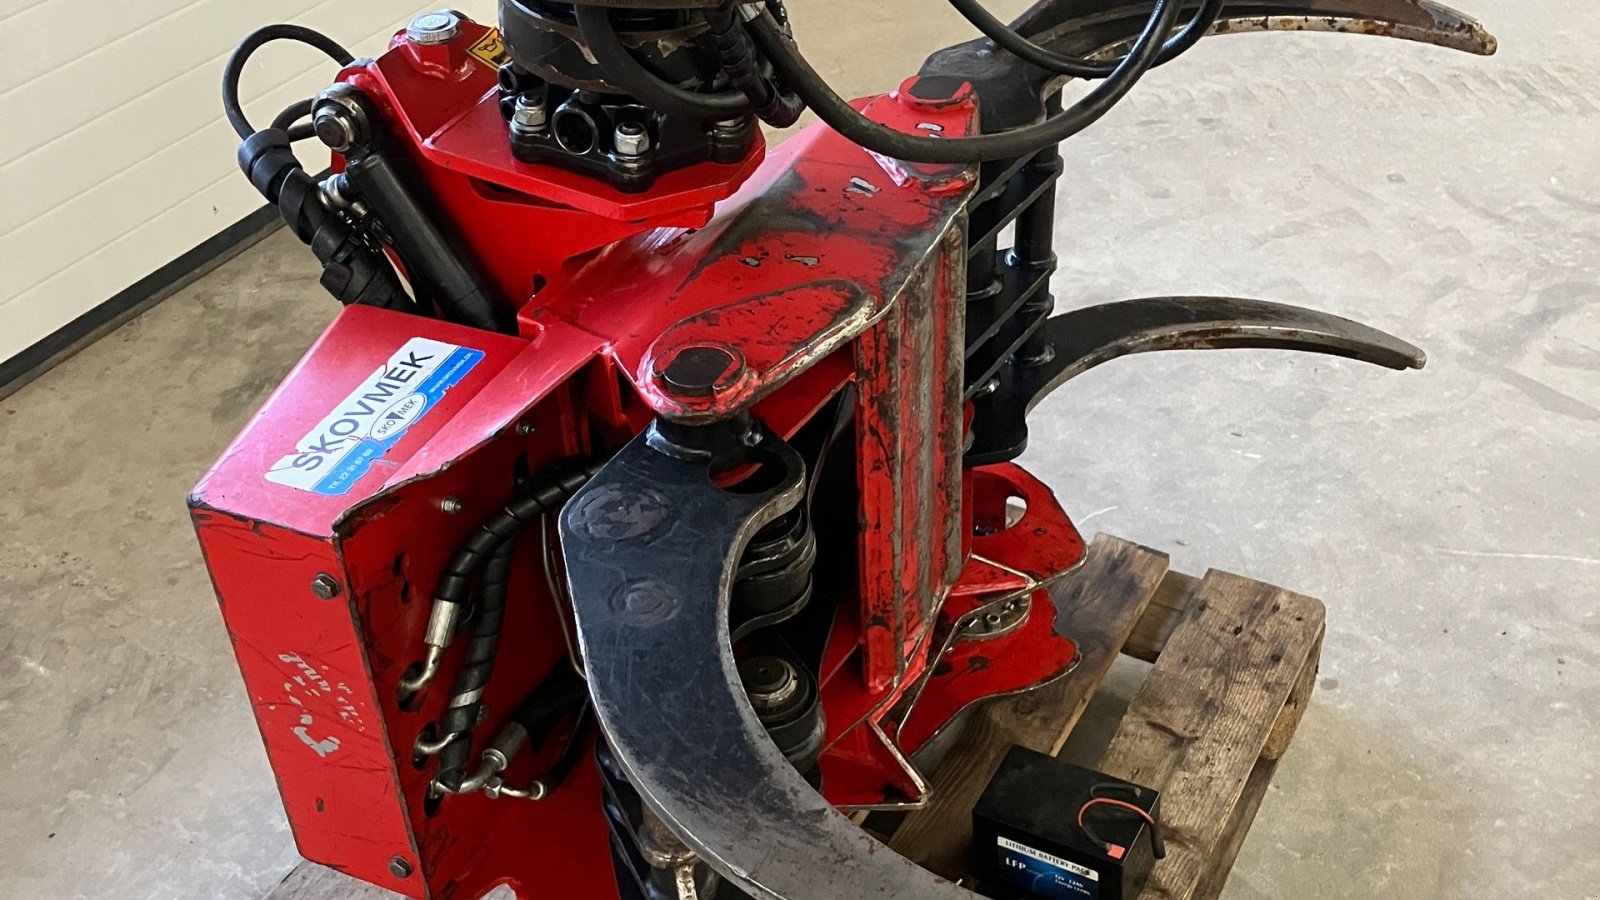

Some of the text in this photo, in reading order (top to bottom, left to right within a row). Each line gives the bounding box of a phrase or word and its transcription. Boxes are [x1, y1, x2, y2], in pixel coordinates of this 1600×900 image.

[293, 350, 435, 472] SKOVMEK
[1005, 857, 1027, 870] LFP
[1038, 853, 1069, 868] BATTERY
